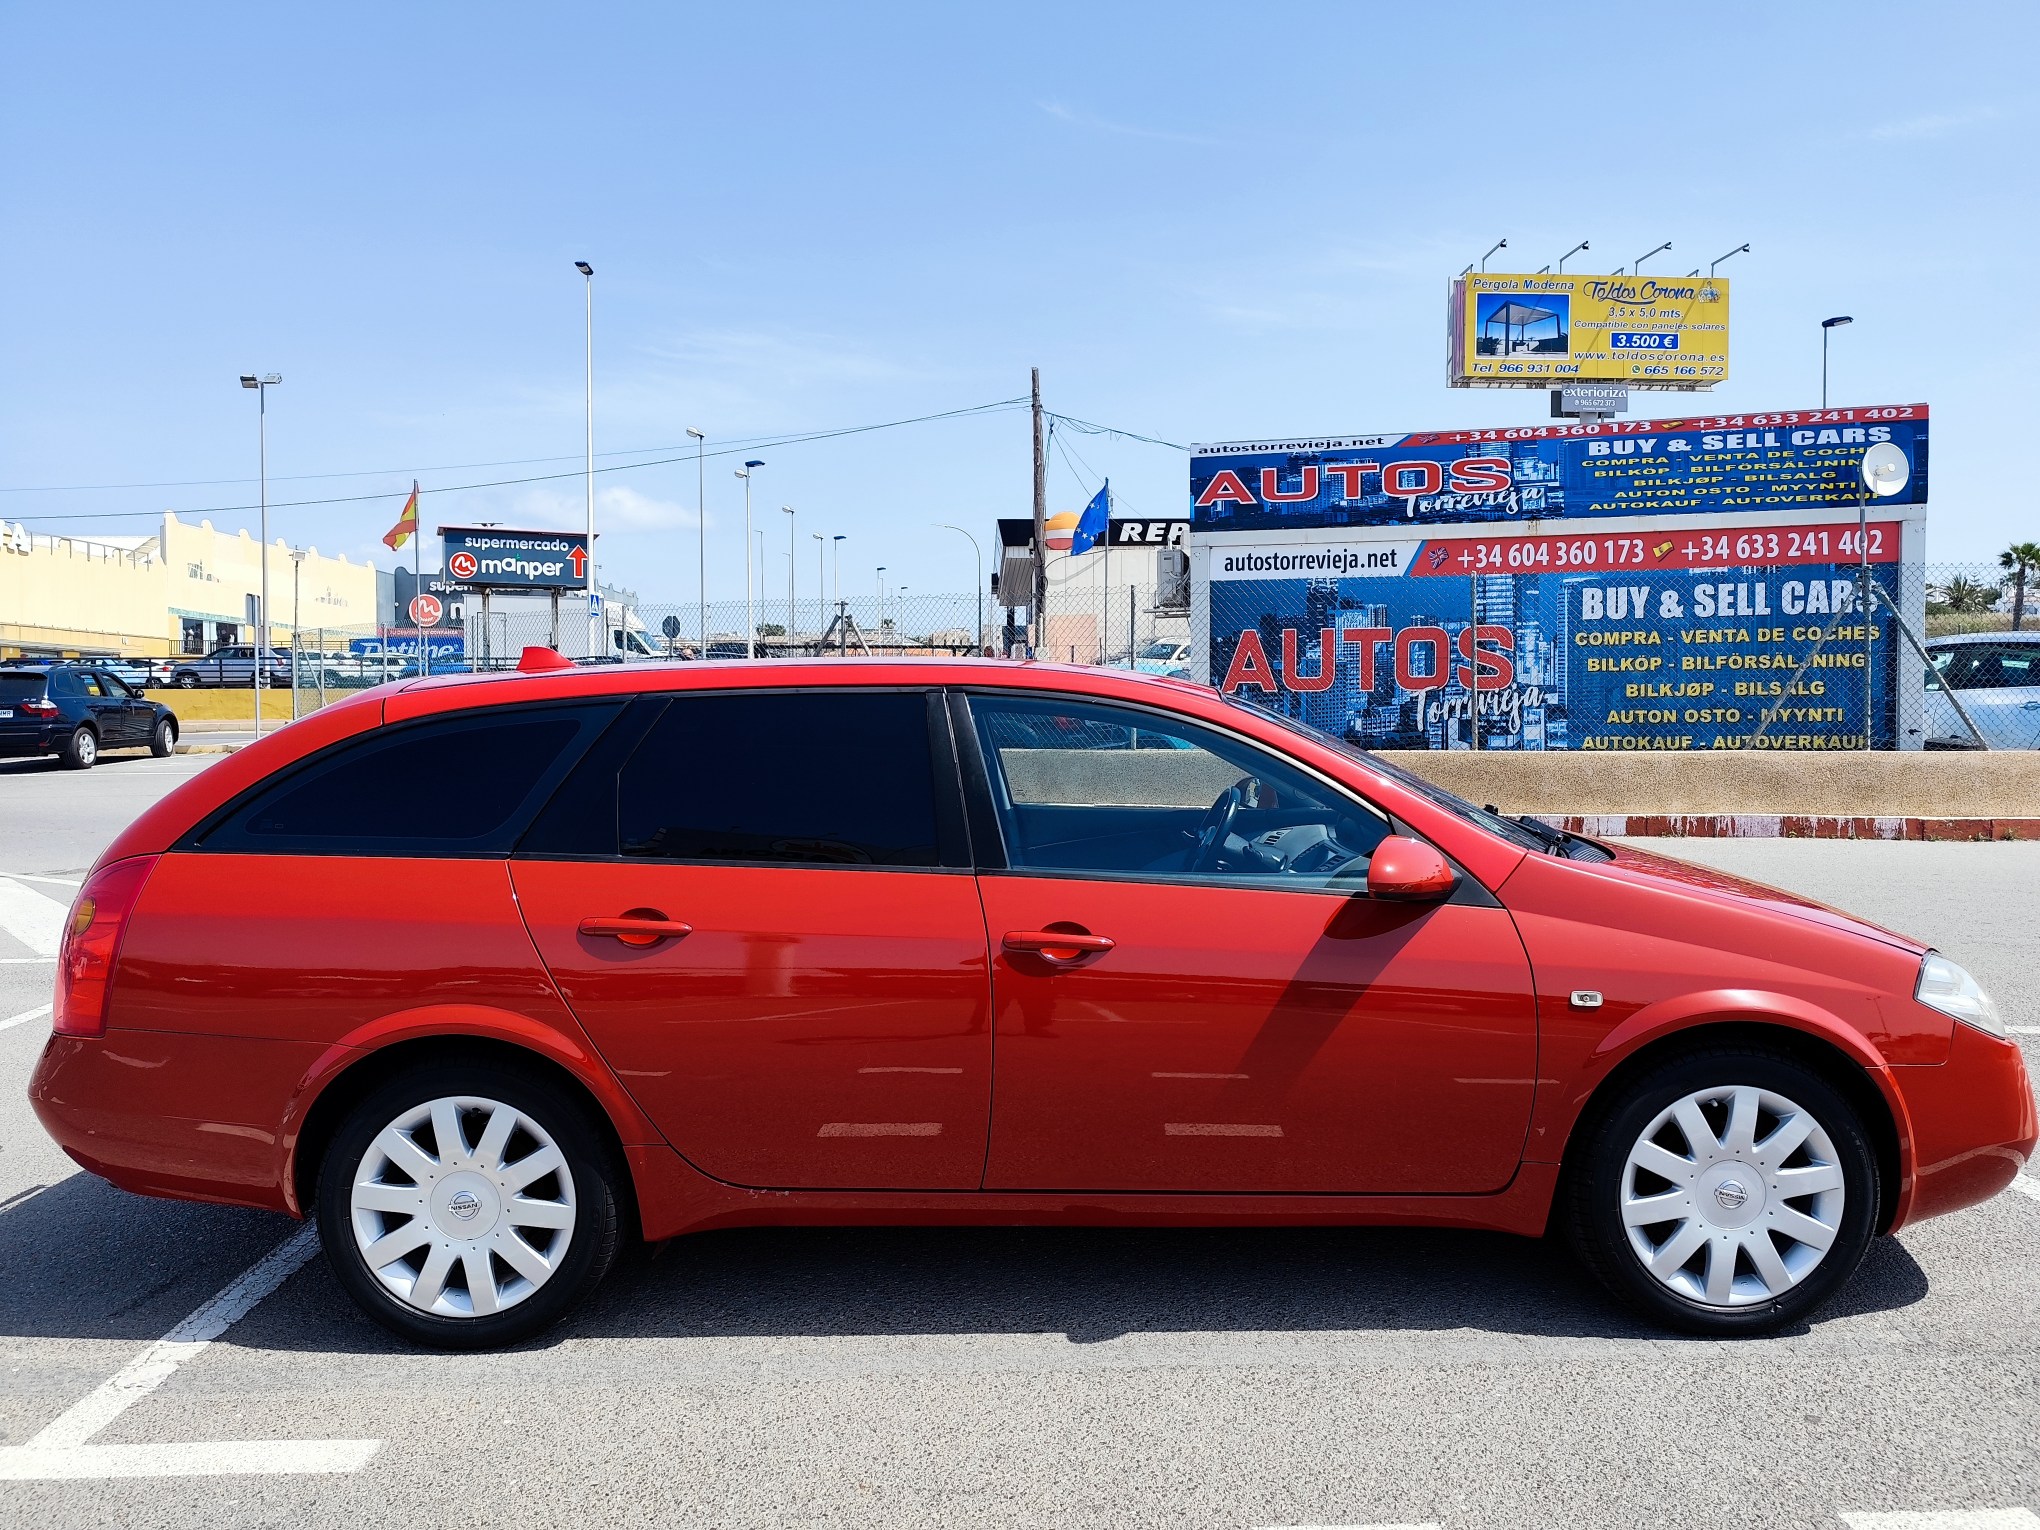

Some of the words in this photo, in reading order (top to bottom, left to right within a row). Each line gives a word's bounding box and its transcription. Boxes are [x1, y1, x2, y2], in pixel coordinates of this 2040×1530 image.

[1523, 279, 1575, 290] Moderna
[1583, 280, 1636, 302] Toldos
[1640, 281, 1695, 300] Corona
[1608, 307, 1625, 318] 3,5
[1629, 309, 1635, 317] x
[1639, 307, 1656, 318] 5,0
[1659, 309, 1684, 318] mts.
[1574, 320, 1628, 329] Compatible
[1652, 322, 1688, 331] paneles
[1691, 322, 1726, 331] solares
[1616, 335, 1660, 347] 3.500
[1663, 336, 1674, 347] €
[1574, 351, 1725, 362] www.toldoscorona.es
[1499, 363, 1523, 373] 966
[1527, 364, 1550, 373] 931
[1554, 364, 1579, 373] 004
[1644, 366, 1669, 375] 665
[1674, 366, 1696, 375] 166
[1699, 366, 1724, 376] 572
[1562, 386, 1627, 398] exterioriza
[1692, 416, 1746, 428] +34
[1752, 413, 1799, 426] 633
[1808, 410, 1855, 423] 241
[1864, 407, 1914, 419] 402
[1449, 429, 1497, 442] +34
[1504, 425, 1548, 439] 604
[1555, 423, 1600, 436] 360
[1608, 421, 1651, 433] 173
[1198, 436, 1385, 454] autostorrevieja.net
[1588, 438, 1657, 456] BUY
[1667, 439, 1692, 452] &
[1702, 431, 1781, 450] SELL
[1791, 426, 1892, 446] CARS
[1582, 457, 1669, 467] COMPRA
[1689, 452, 1759, 461] VENTA
[1768, 450, 1795, 458] DE
[1803, 447, 1871, 456] COCH
[1594, 467, 1670, 477] BILKÖP
[1691, 459, 1860, 473] BILFÖRSÄLJNIN
[1194, 456, 1512, 506] AUTOS
[1633, 476, 1724, 487] BILKJØP
[1744, 471, 1837, 482] BILSALG
[1614, 489, 1686, 498] AUTON
[1693, 486, 1750, 495] OSTO
[1771, 481, 1856, 492] MYYNTI
[1399, 486, 1544, 517] Torrevieja
[1588, 499, 1702, 510] AUTOKAUF
[464, 537, 569, 551] supermercado
[1681, 535, 1729, 561] +34
[1736, 533, 1780, 559] 633
[1787, 531, 1829, 557] 241
[1838, 529, 1883, 555] 402
[1224, 548, 1398, 573] autostorrevieja.net
[1457, 544, 1503, 569] +34
[1507, 542, 1550, 567] 604
[1555, 540, 1597, 565] 360
[1604, 538, 1644, 563] 173
[481, 557, 564, 580] manper
[1582, 585, 1650, 620] BUY
[1659, 589, 1684, 619] &
[1693, 581, 1771, 619] SELL
[1781, 579, 1879, 615] CARS
[1575, 631, 1661, 646] COMPRA
[1681, 628, 1750, 644] VENTA
[1757, 627, 1785, 642] DE
[1221, 624, 1514, 694] AUTOS
[1587, 654, 1662, 672] BILKÖP
[1681, 653, 1865, 671] BILFÖRSÄLNING
[1626, 682, 1714, 697] BILKJØP
[1607, 709, 1677, 724] AUTON
[1684, 708, 1740, 723] OSTO
[1582, 735, 1693, 750] AUTOKAUF
[450, 1202, 478, 1211] NISSAN
